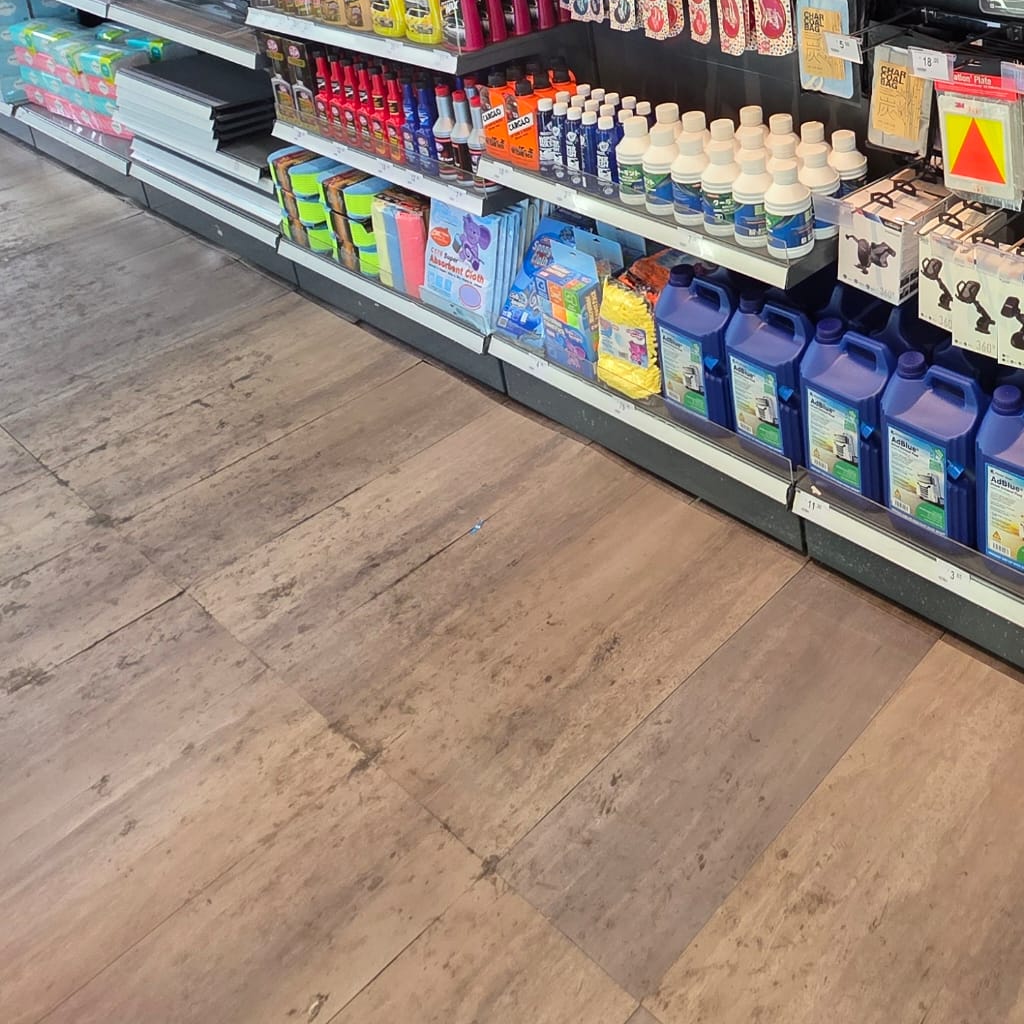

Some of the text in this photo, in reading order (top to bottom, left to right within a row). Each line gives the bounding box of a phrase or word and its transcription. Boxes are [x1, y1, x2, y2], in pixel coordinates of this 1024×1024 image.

[803, 11, 824, 21] CHAR
[804, 17, 824, 27] COAL
[804, 24, 820, 32] BAG
[881, 66, 907, 78] CHAR
[880, 74, 904, 84] COAL
[974, 76, 992, 86] Plate
[880, 80, 898, 90] BAG
[955, 101, 965, 109] 3M
[482, 109, 502, 122] CARGLO
[508, 117, 531, 132] CARGLO
[430, 256, 464, 276] Absorbent
[464, 268, 485, 283] Cloth
